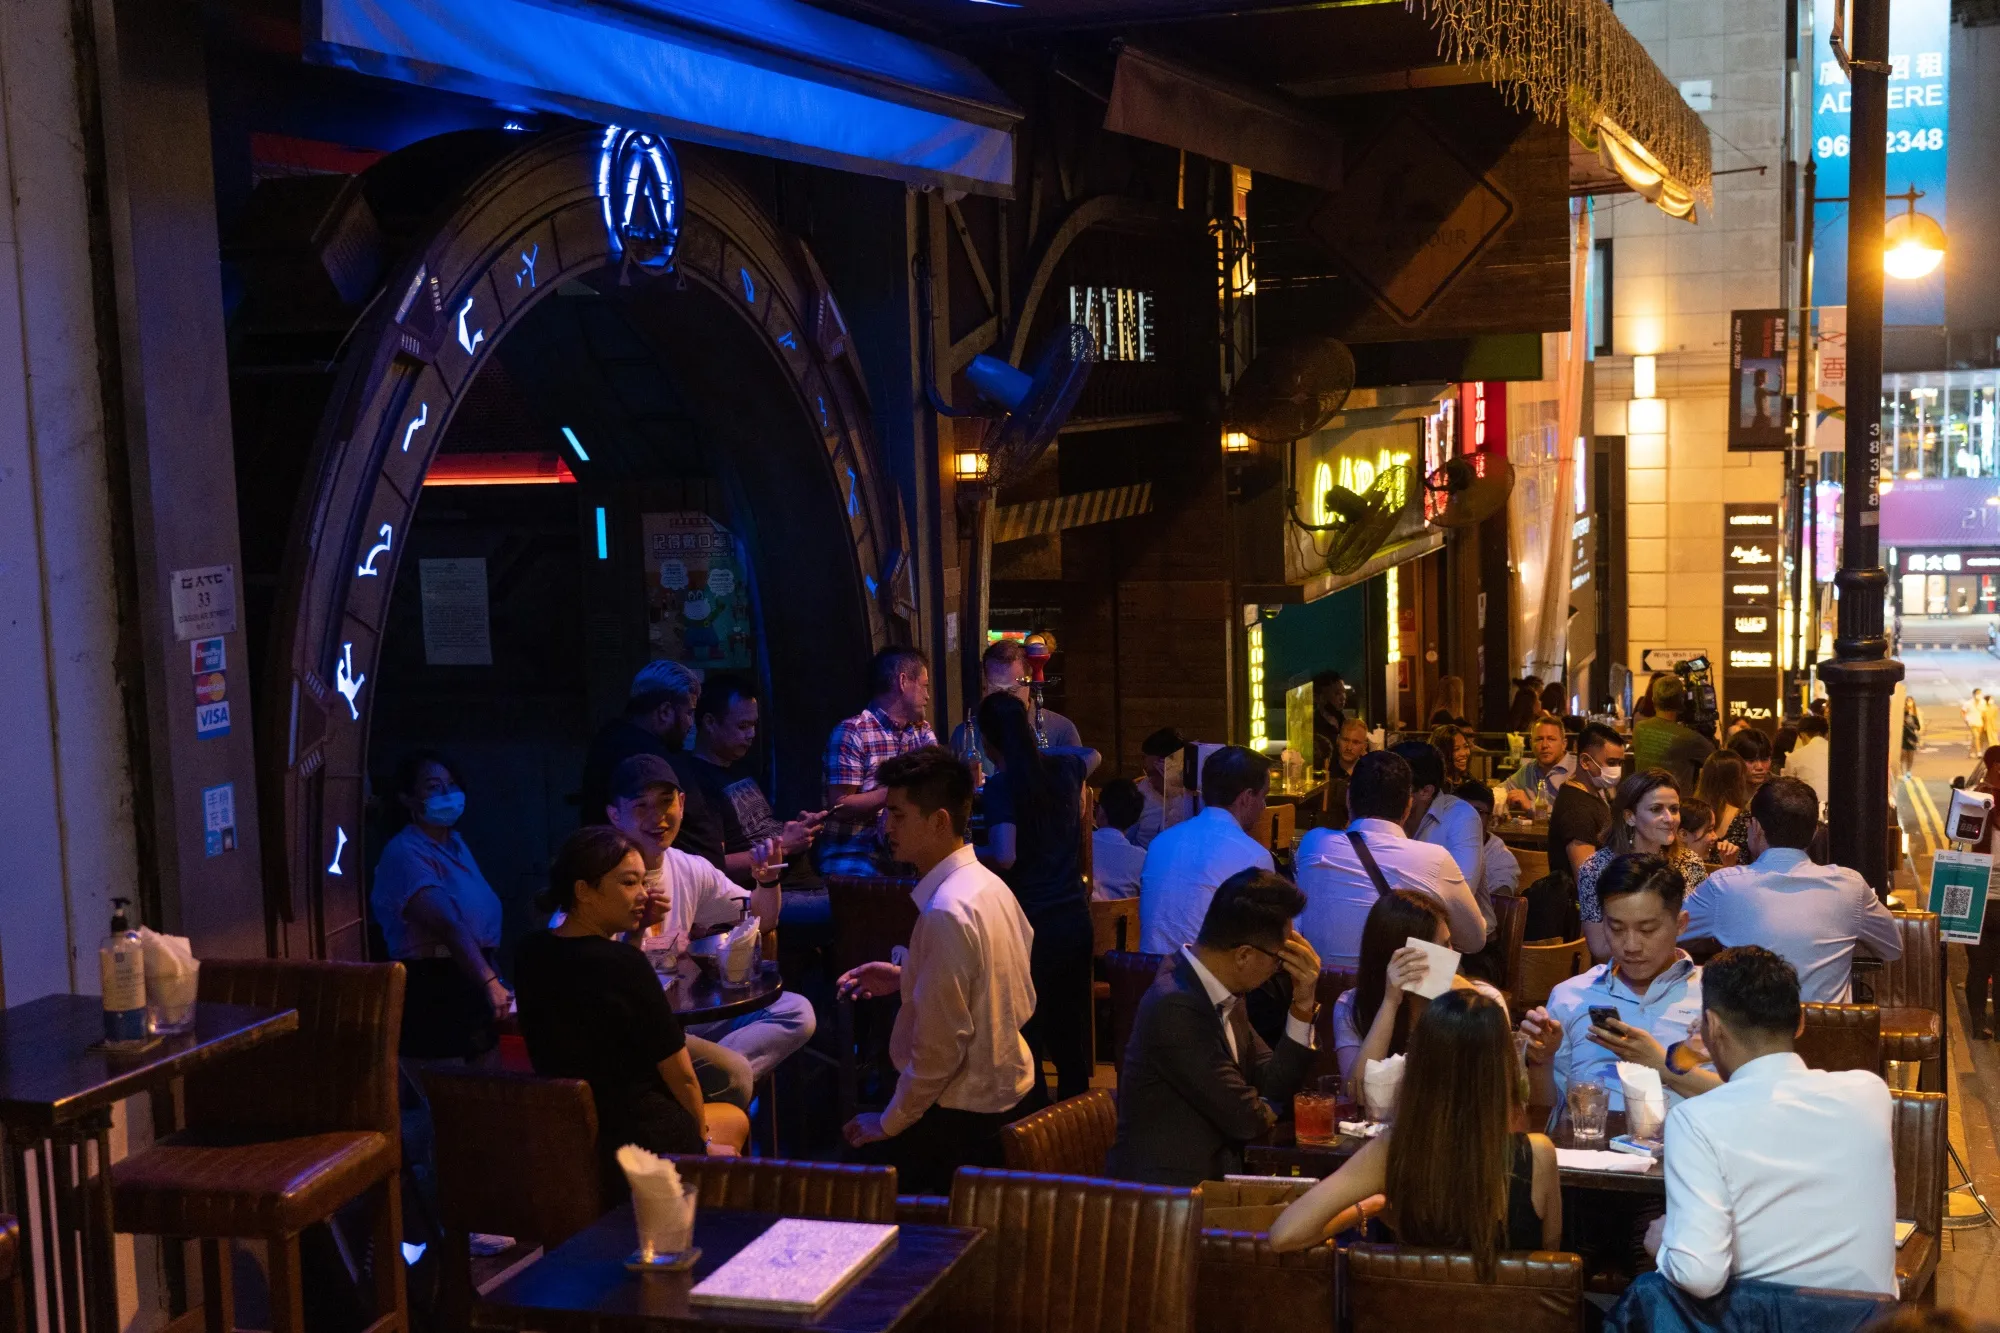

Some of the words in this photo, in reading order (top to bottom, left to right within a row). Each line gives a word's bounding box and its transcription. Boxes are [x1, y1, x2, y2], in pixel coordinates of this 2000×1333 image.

[1887, 84, 1943, 109] ERE
[1886, 128, 1943, 153] 2348
[1730, 701, 1747, 709] THE
[1730, 708, 1771, 720] PLAZA
[200, 708, 229, 726] VISA
